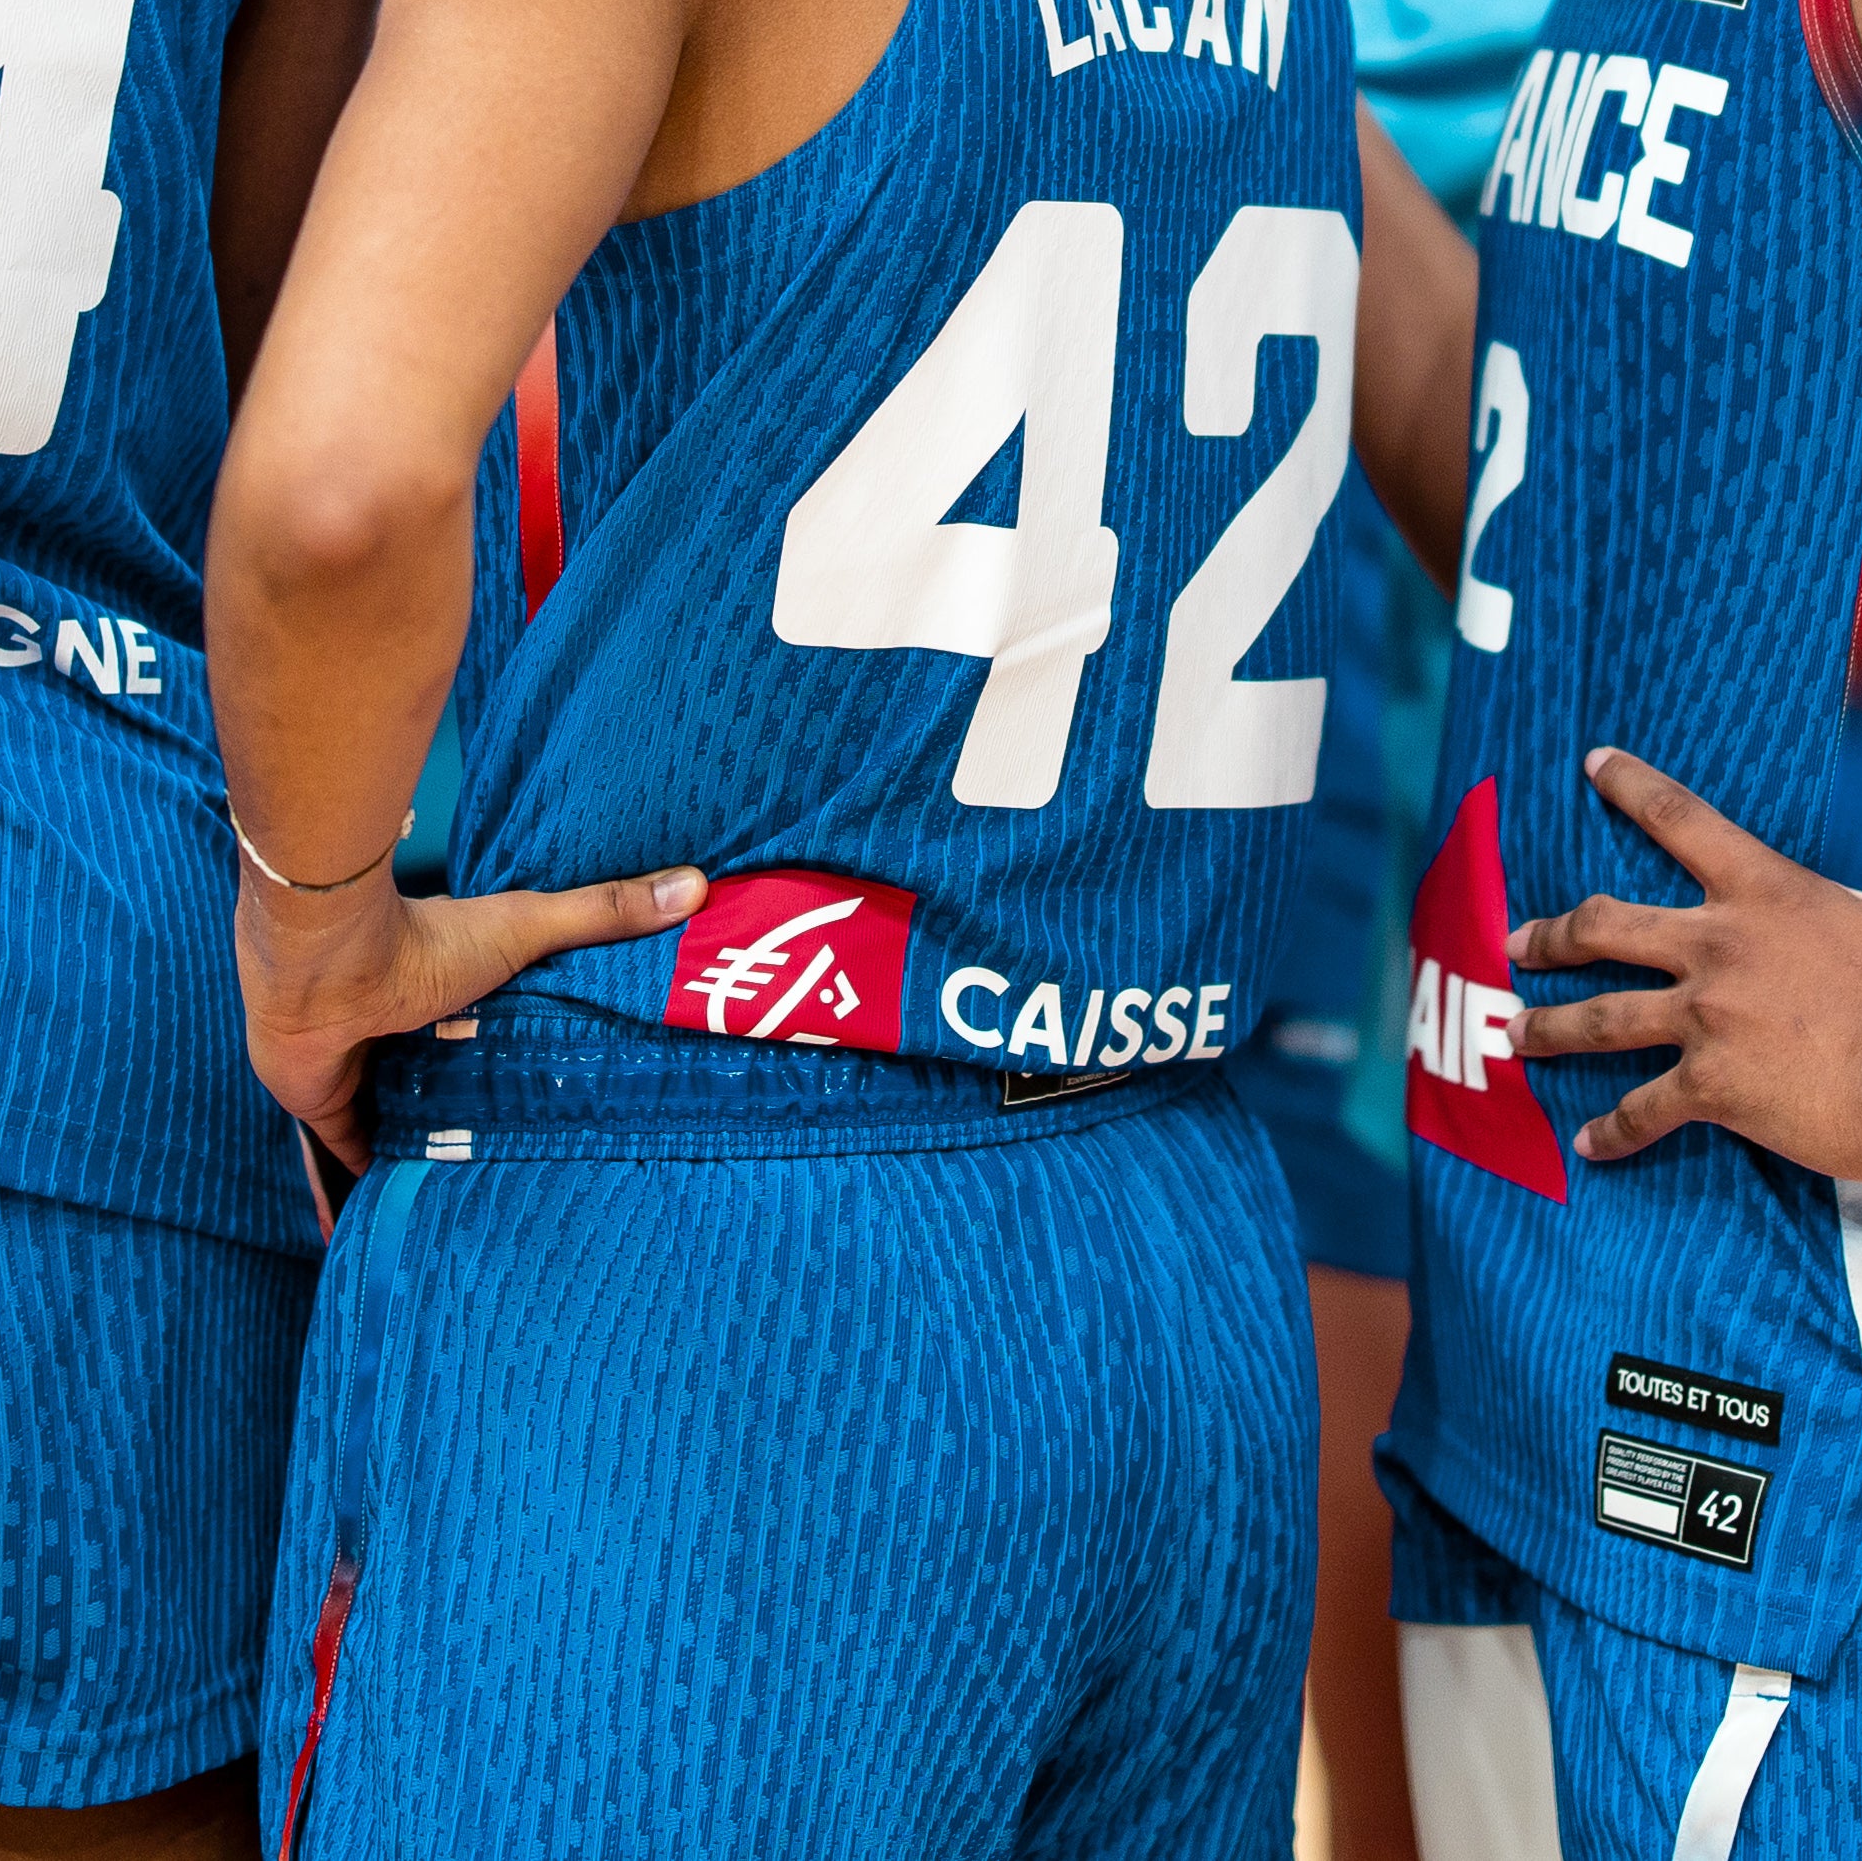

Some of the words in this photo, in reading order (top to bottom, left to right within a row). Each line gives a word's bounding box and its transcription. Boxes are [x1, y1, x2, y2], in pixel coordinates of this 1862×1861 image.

[1479, 48, 1729, 269] ANCE
[771, 200, 1359, 809] 42
[1455, 340, 1530, 654] 2
[940, 966, 1231, 1067] CAISSE
[1406, 945, 1526, 1092] AIF
[1617, 1368, 1684, 1406] TOUTES
[1687, 1387, 1712, 1413] ET
[1715, 1393, 1771, 1428] TOUS
[1697, 1489, 1743, 1534] 42
